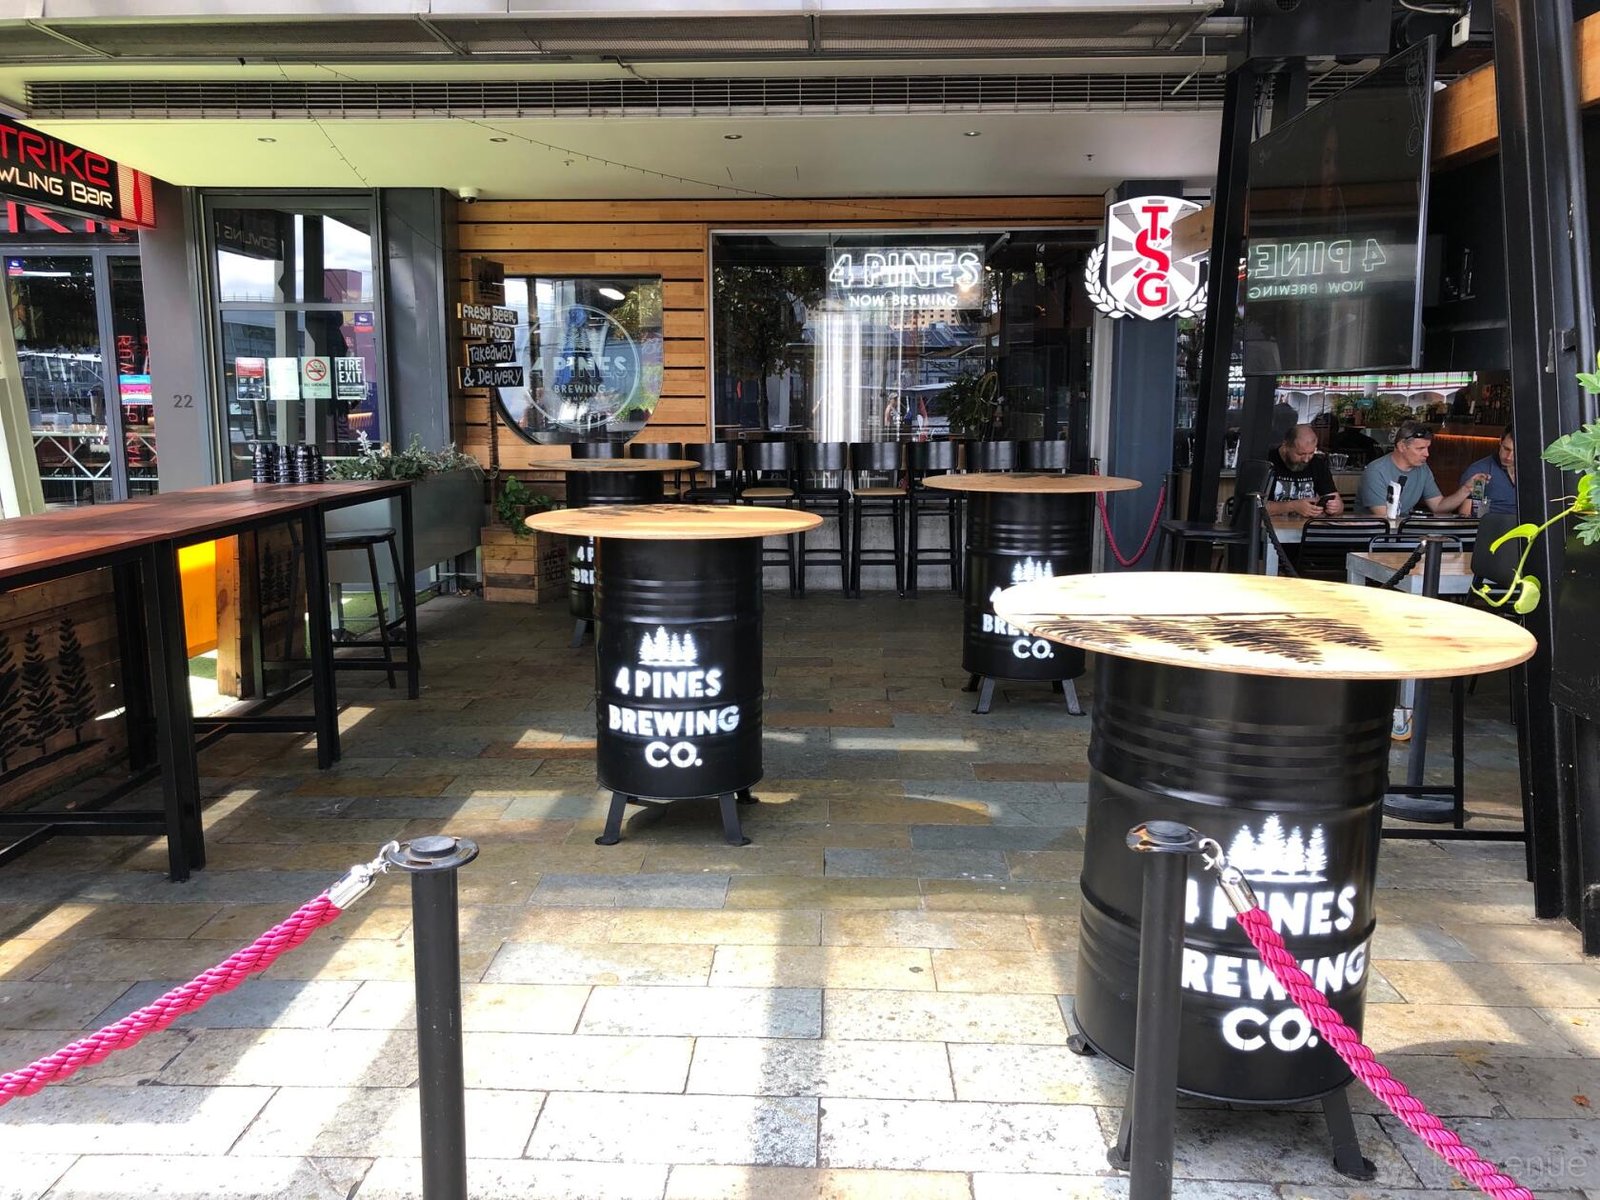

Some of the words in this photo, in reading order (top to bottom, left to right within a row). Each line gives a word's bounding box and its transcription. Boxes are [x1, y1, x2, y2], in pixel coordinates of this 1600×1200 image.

[1133, 205, 1171, 308] TSG
[829, 254, 854, 288] 4
[864, 252, 979, 288] PINES
[850, 294, 885, 307] NOW
[893, 294, 958, 307] BREWING
[470, 322, 488, 337] HOT
[489, 325, 512, 341] FOOD
[338, 360, 362, 371] FIRE
[552, 356, 629, 378] PINES
[339, 371, 362, 384] EXIT
[463, 367, 476, 388] &
[554, 384, 607, 394] BREWING
[173, 394, 194, 409] 22
[1012, 639, 1055, 659] CO.
[615, 666, 631, 695] 4
[634, 668, 724, 699] PINES
[608, 703, 740, 738] BREWING
[644, 740, 703, 769] CO.
[1222, 1006, 1319, 1052] CO.
